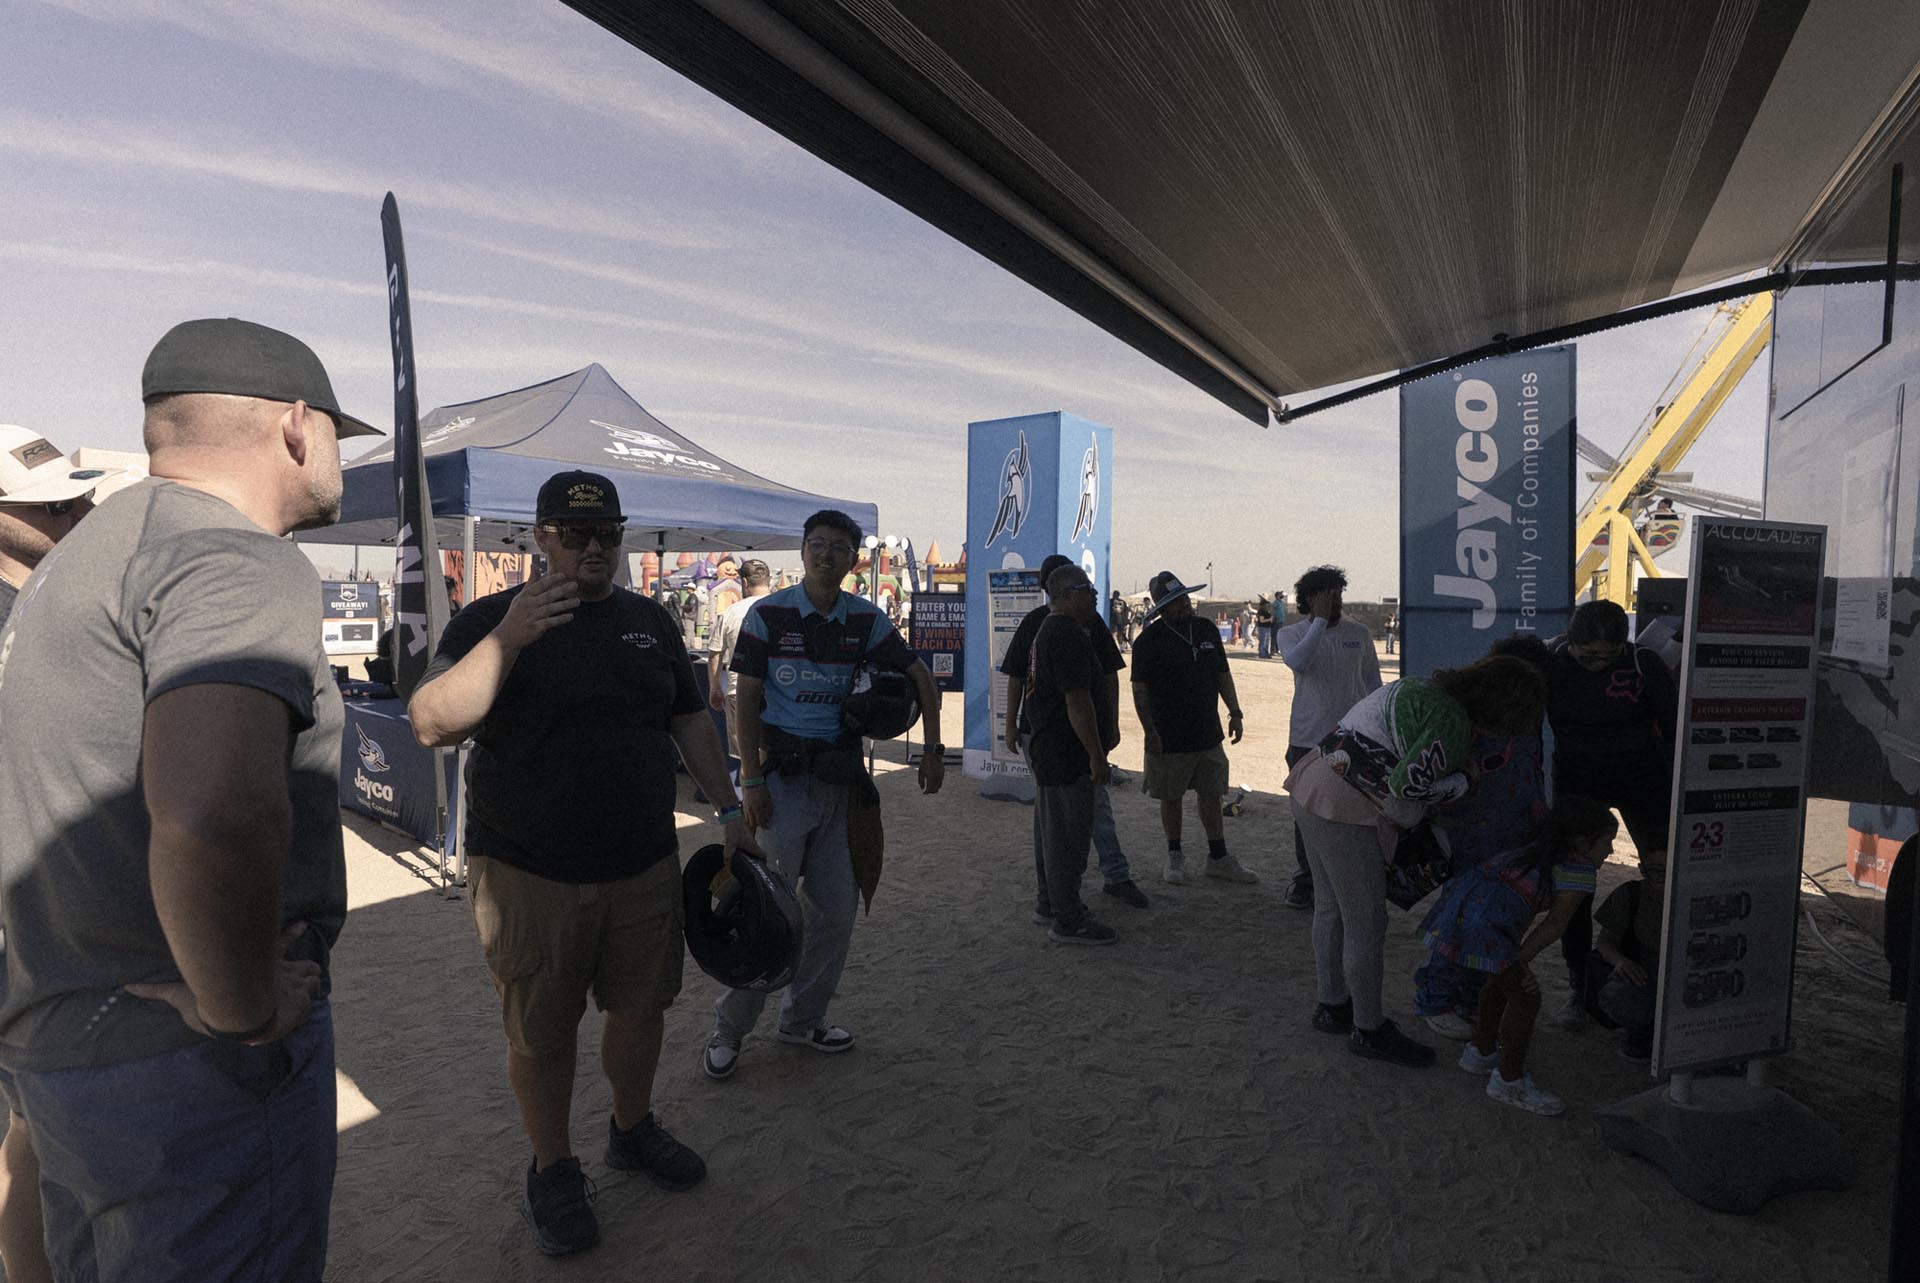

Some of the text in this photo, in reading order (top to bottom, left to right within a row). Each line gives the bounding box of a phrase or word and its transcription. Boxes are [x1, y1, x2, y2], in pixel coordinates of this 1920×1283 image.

[603, 442, 721, 471] Jayco
[567, 484, 604, 497] METHOD
[1434, 379, 1511, 629] Jayco
[1515, 371, 1543, 631] Family of Companies
[1705, 524, 1802, 545] ACCOLADE
[916, 602, 945, 612] ENTER
[915, 612, 938, 622] NAME
[940, 613, 946, 622] &
[915, 628, 965, 639] 9 WINNER
[915, 639, 943, 650] EACH
[354, 767, 393, 802] Jayco
